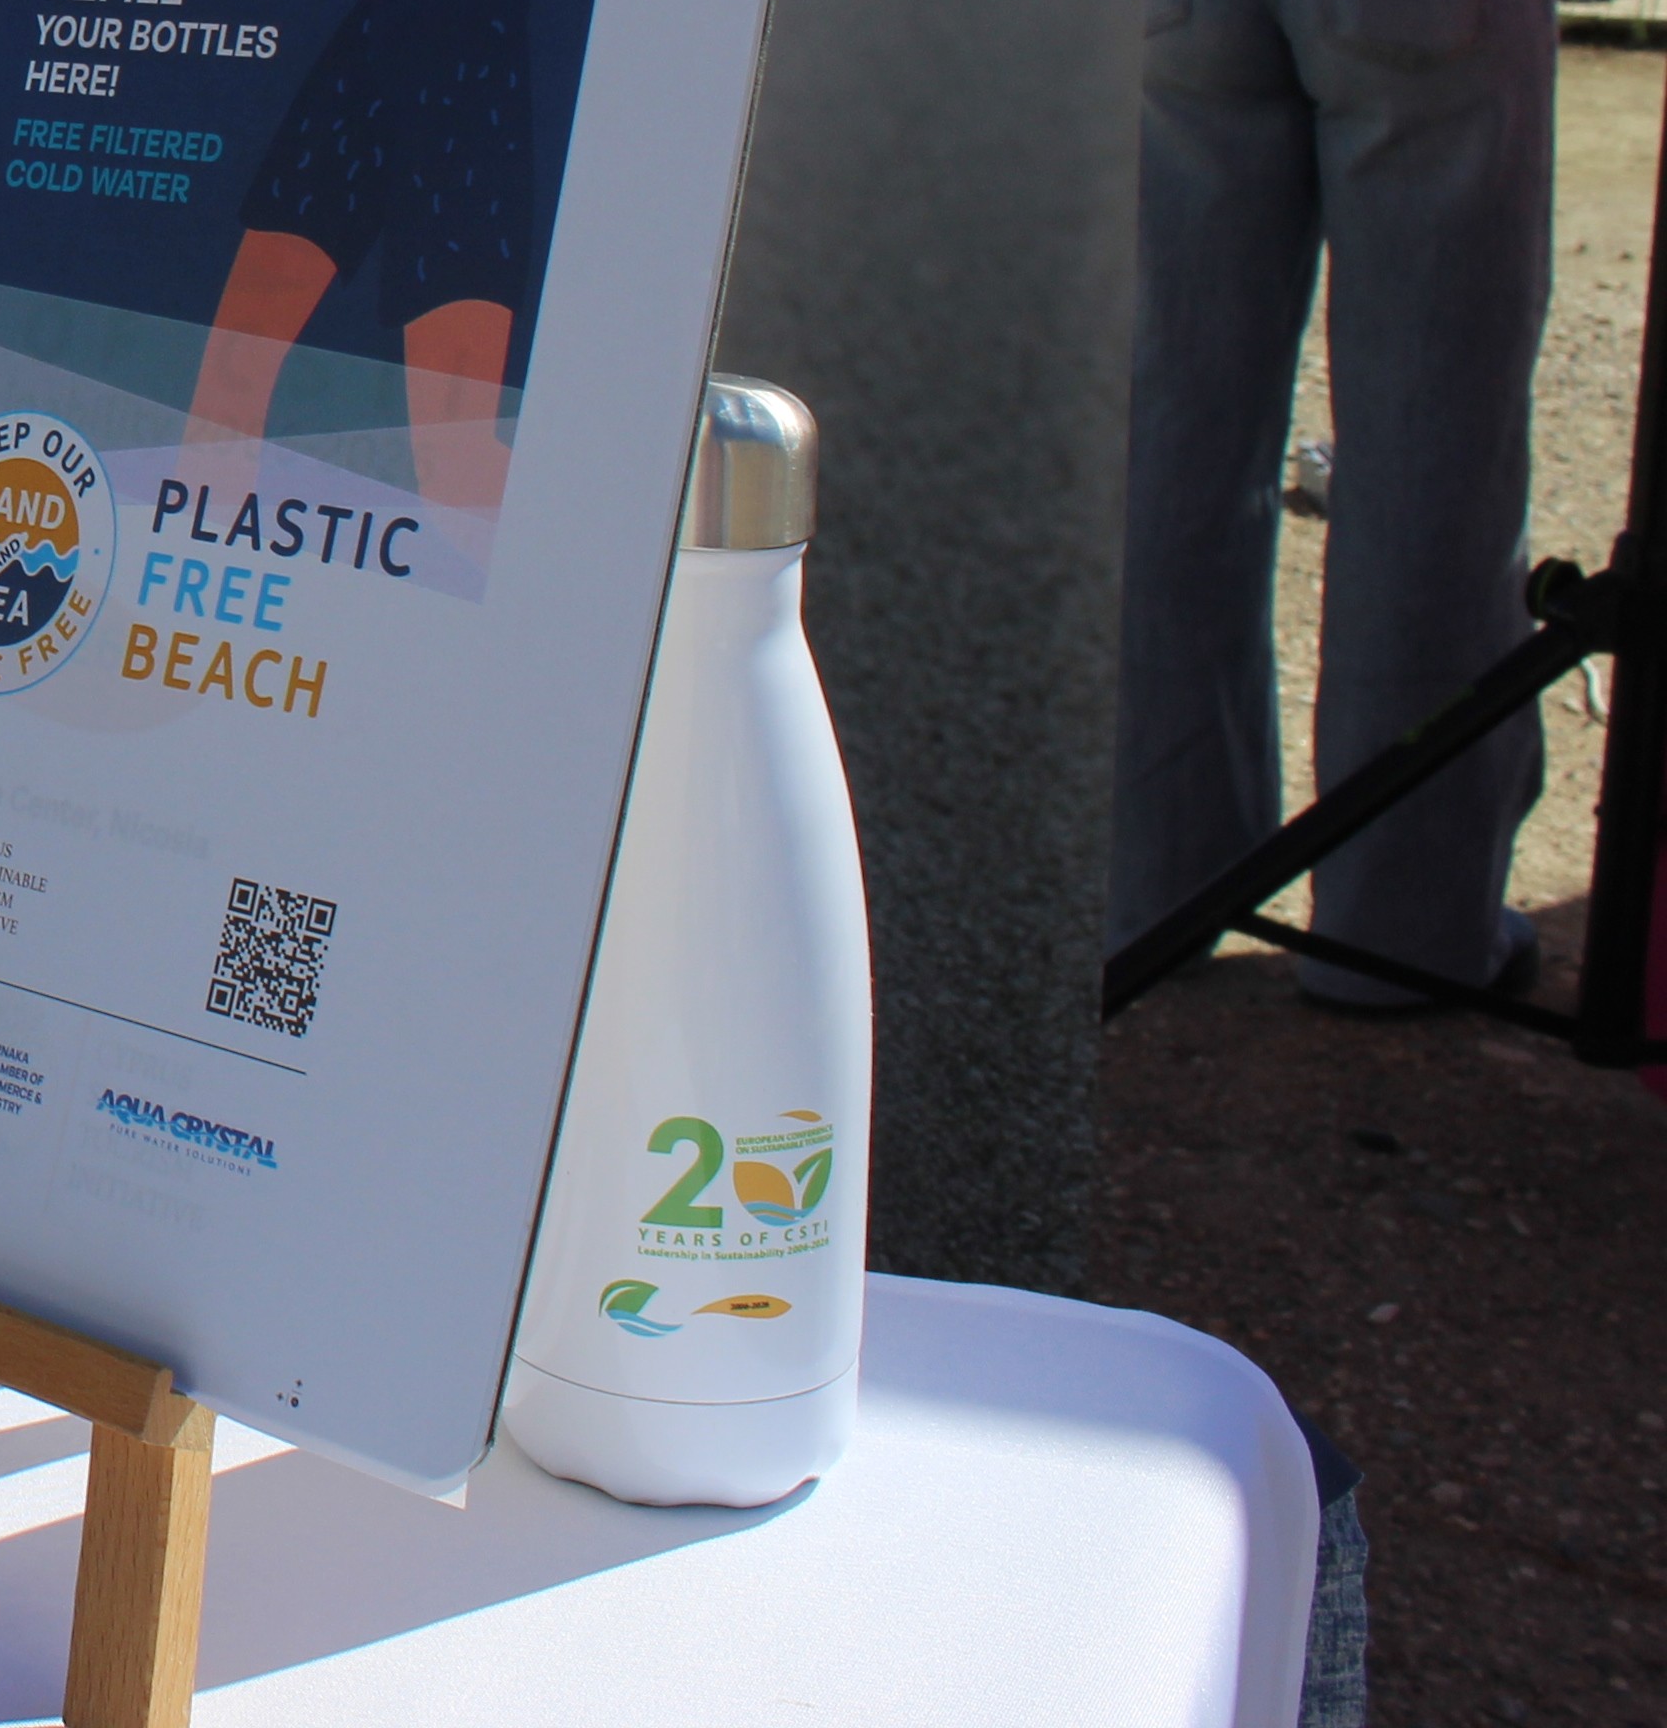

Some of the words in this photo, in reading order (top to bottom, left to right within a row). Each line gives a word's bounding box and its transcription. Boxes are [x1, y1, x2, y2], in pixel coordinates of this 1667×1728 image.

[37, 13, 122, 50] YOUR
[129, 19, 279, 59] BOTTLES
[24, 60, 120, 97] HERE!
[13, 118, 84, 151] FREE
[89, 125, 223, 162] FILTERED
[6, 159, 83, 192] COLD
[92, 166, 190, 204] WATER
[42, 430, 96, 498] OUR
[152, 479, 419, 577] PLASTIC
[137, 551, 291, 632] FREE
[18, 589, 92, 675] FREE
[121, 623, 327, 718] BEACH
[29, 1073, 44, 1086] OF
[34, 1092, 42, 1104] &
[96, 1088, 168, 1132] AQUA
[170, 1112, 277, 1169] CRYSTAL
[109, 1123, 137, 1139] PURE
[143, 1134, 179, 1153] WATER
[186, 1148, 251, 1176] SOLUTIONS
[736, 1132, 785, 1146] EUROPEAN
[637, 1227, 722, 1247] YEARS
[740, 1231, 768, 1246] OF
[784, 1219, 828, 1242] CSTI
[637, 1246, 698, 1261] Leadership
[702, 1249, 711, 1260] in
[715, 1247, 785, 1261] Sustainability
